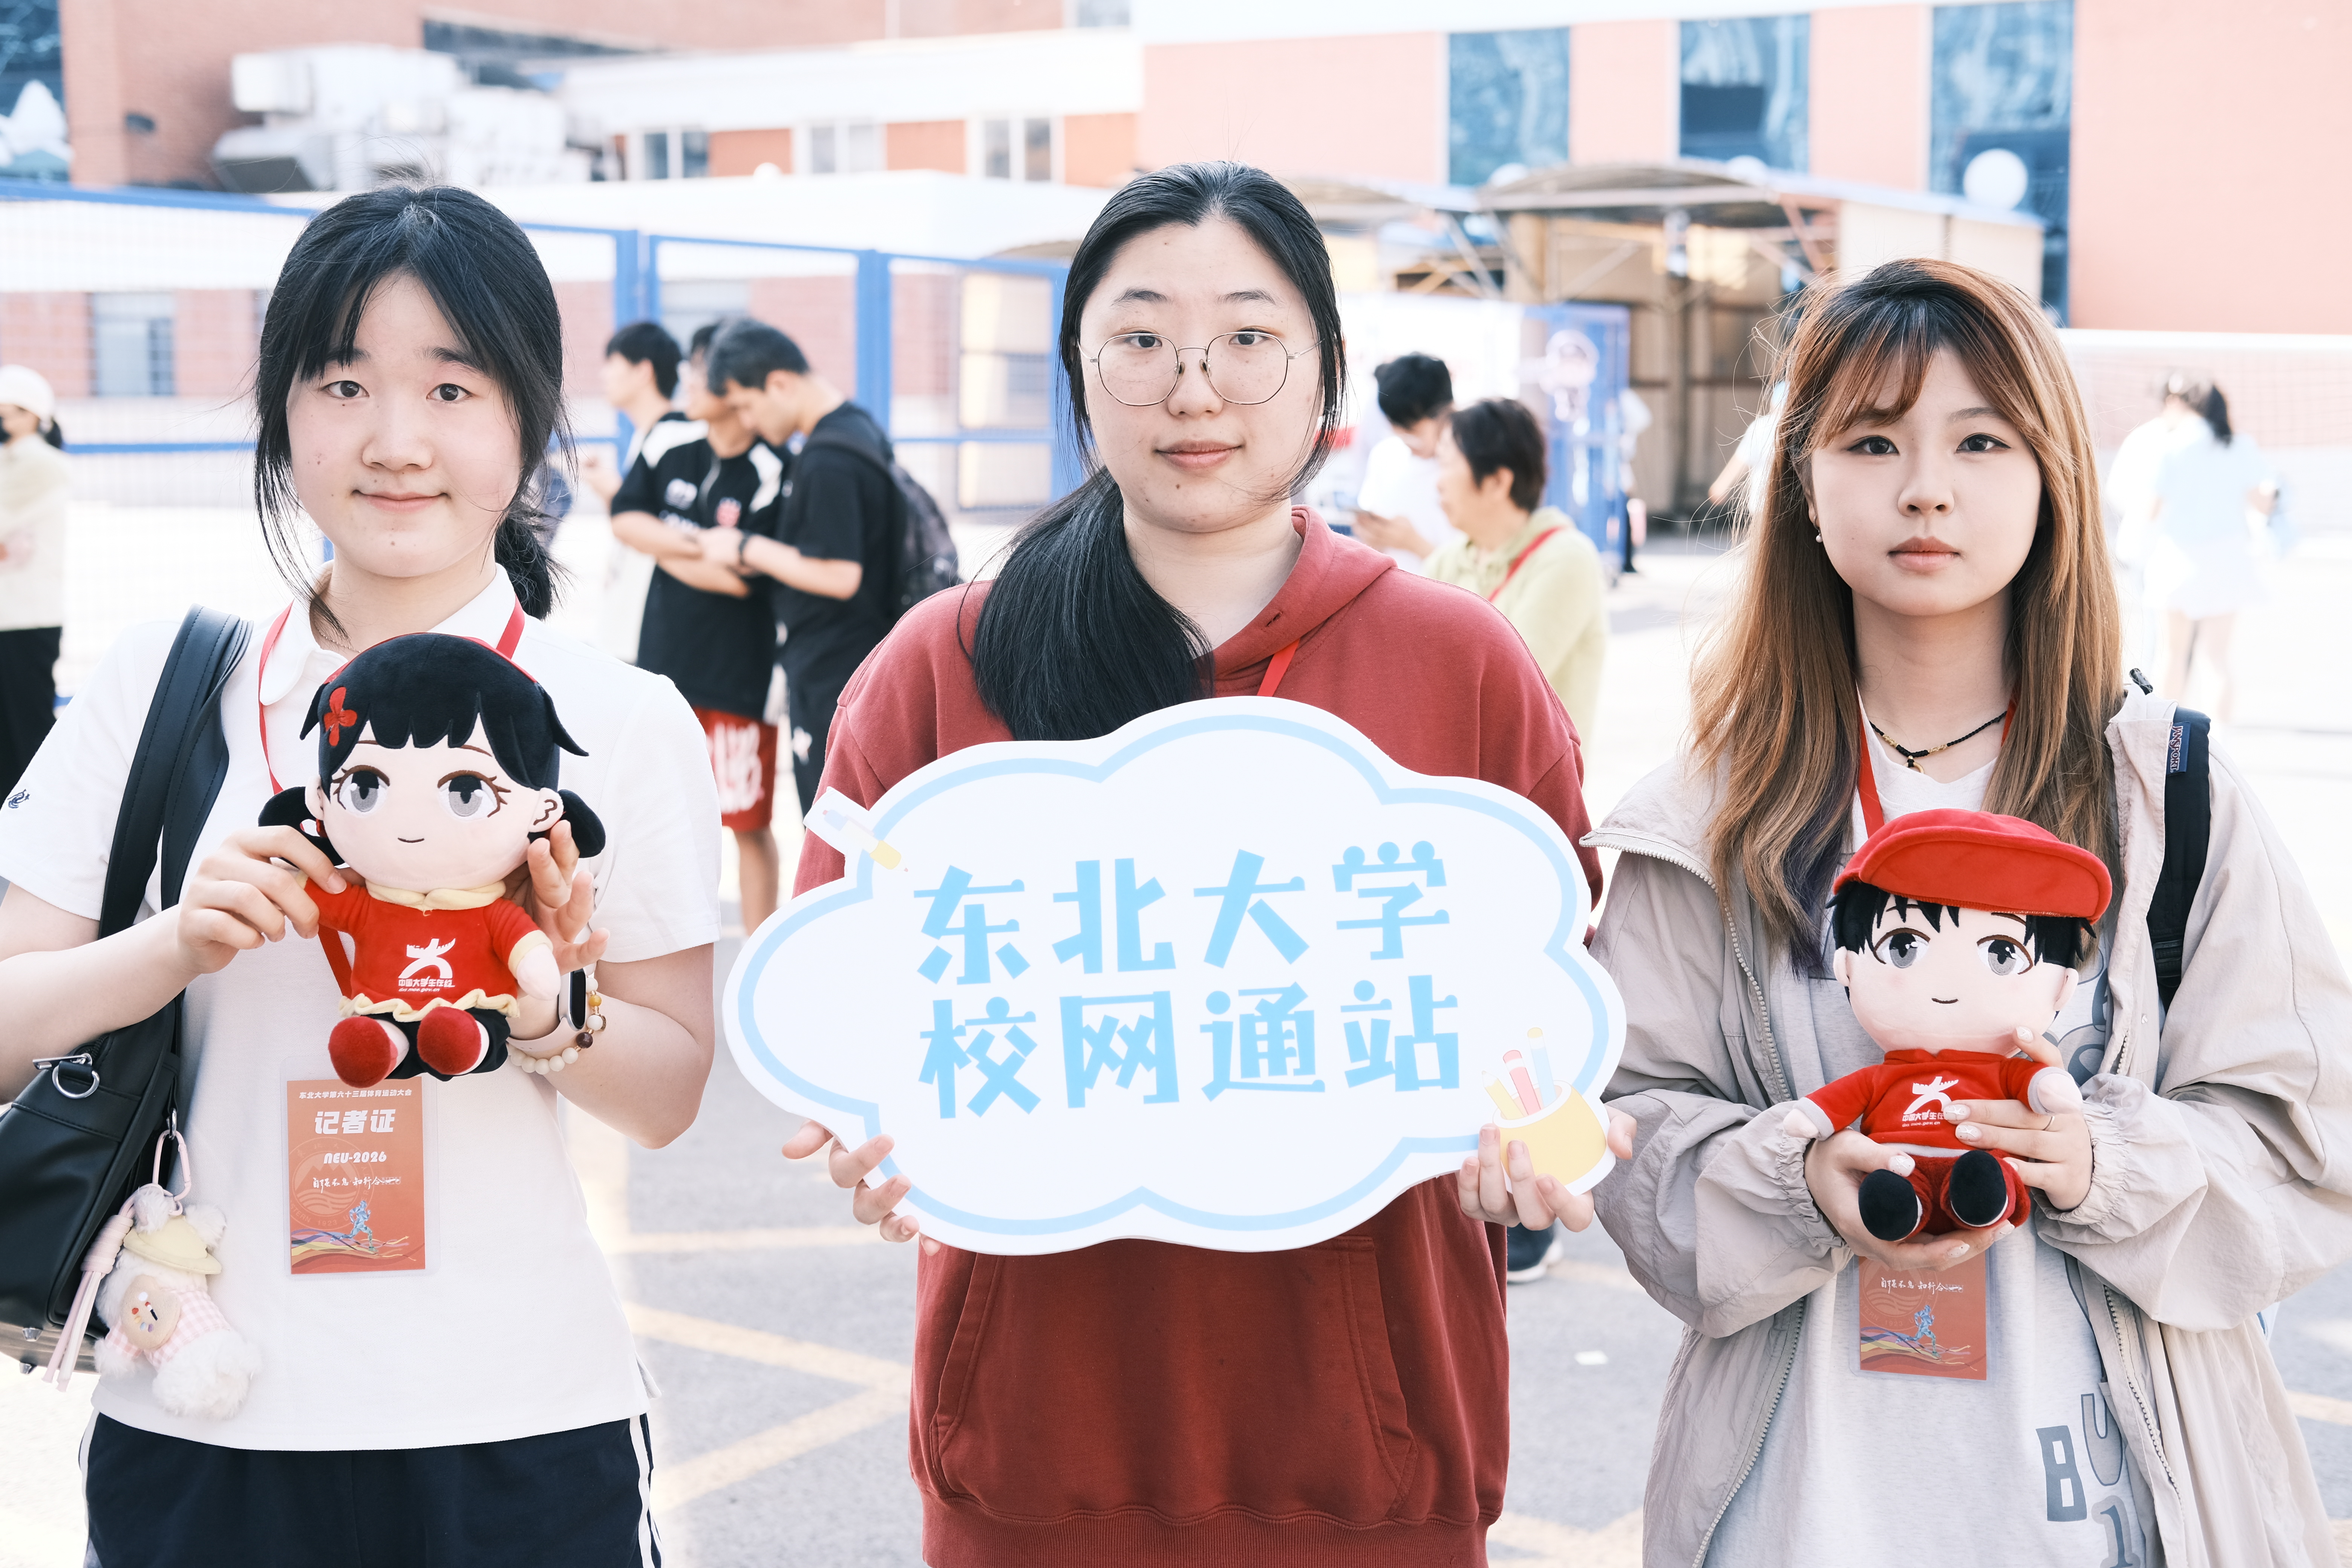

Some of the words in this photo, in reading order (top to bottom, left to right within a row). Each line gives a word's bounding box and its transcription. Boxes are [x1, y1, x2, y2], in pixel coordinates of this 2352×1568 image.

[2169, 726, 2184, 771] JANSPORT
[913, 841, 1450, 985] 东北大学
[918, 974, 1460, 1119] 校网通站
[299, 1089, 412, 1099] 东北大学第六十三届体育运动大会
[314, 1109, 396, 1135] 记者证
[1902, 1109, 1945, 1122] 中国大学生在
[323, 1151, 387, 1164] NEU-2026
